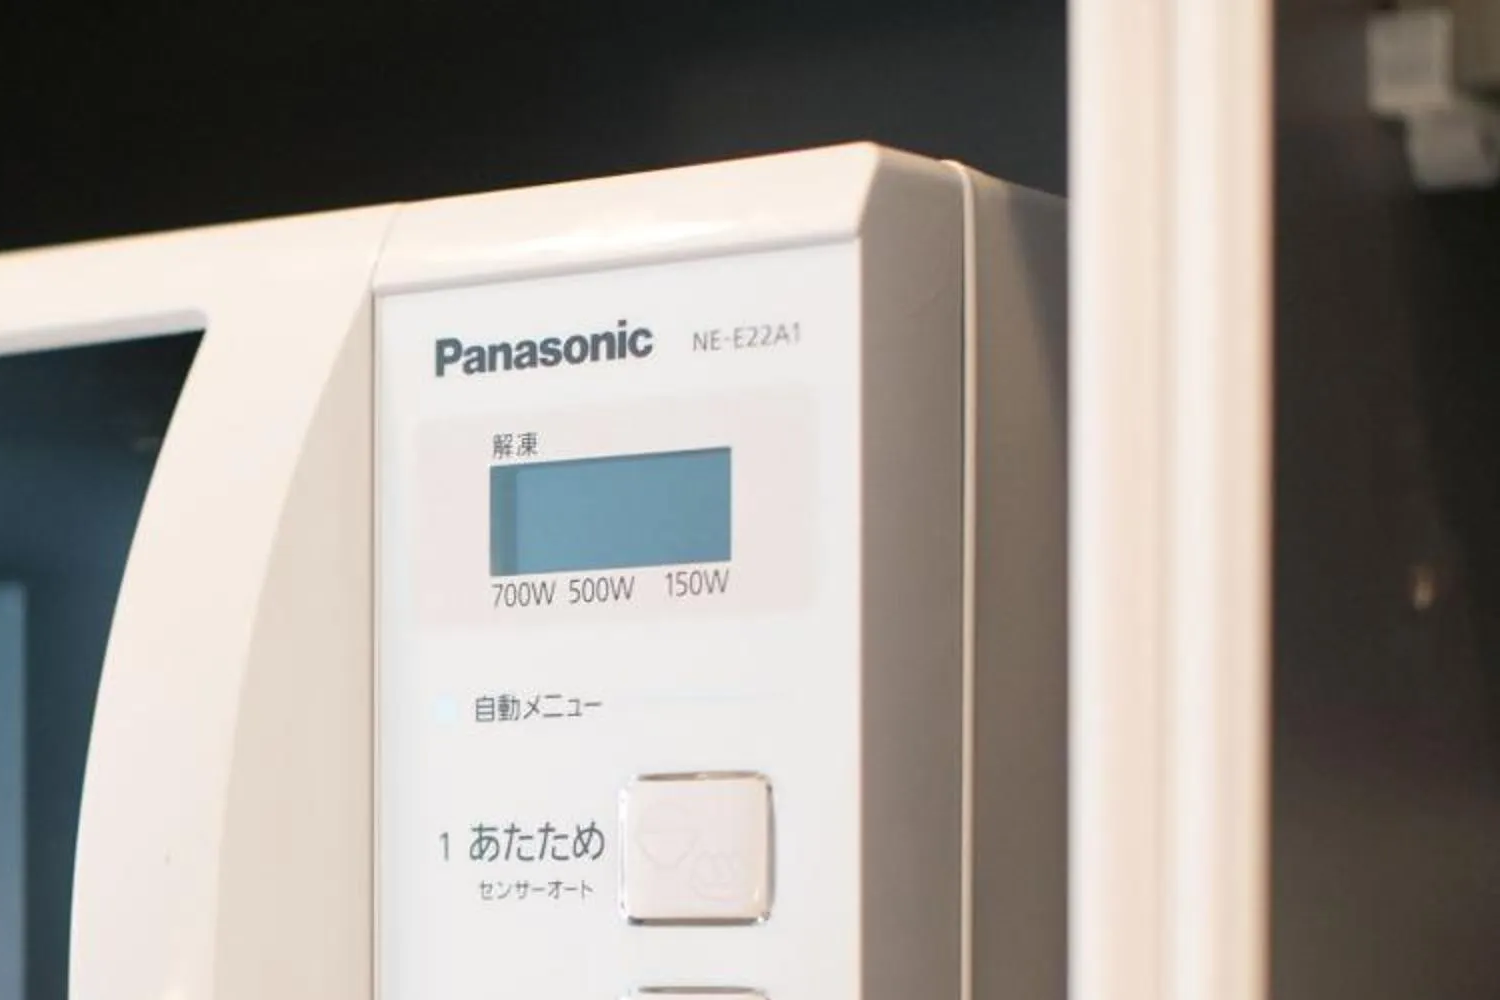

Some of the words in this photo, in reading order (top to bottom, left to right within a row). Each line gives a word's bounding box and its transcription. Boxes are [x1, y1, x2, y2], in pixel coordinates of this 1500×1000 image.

[435, 319, 653, 377] Panasonic
[692, 322, 802, 351] NE-E22A1
[493, 432, 538, 458] 解凍
[492, 580, 556, 607] 700W
[569, 575, 635, 603] 500W
[665, 569, 730, 597] 150W
[475, 693, 603, 723] 自動メニュー
[438, 832, 451, 861] 1
[468, 821, 606, 863] あたため
[479, 880, 593, 901] センサーオート
